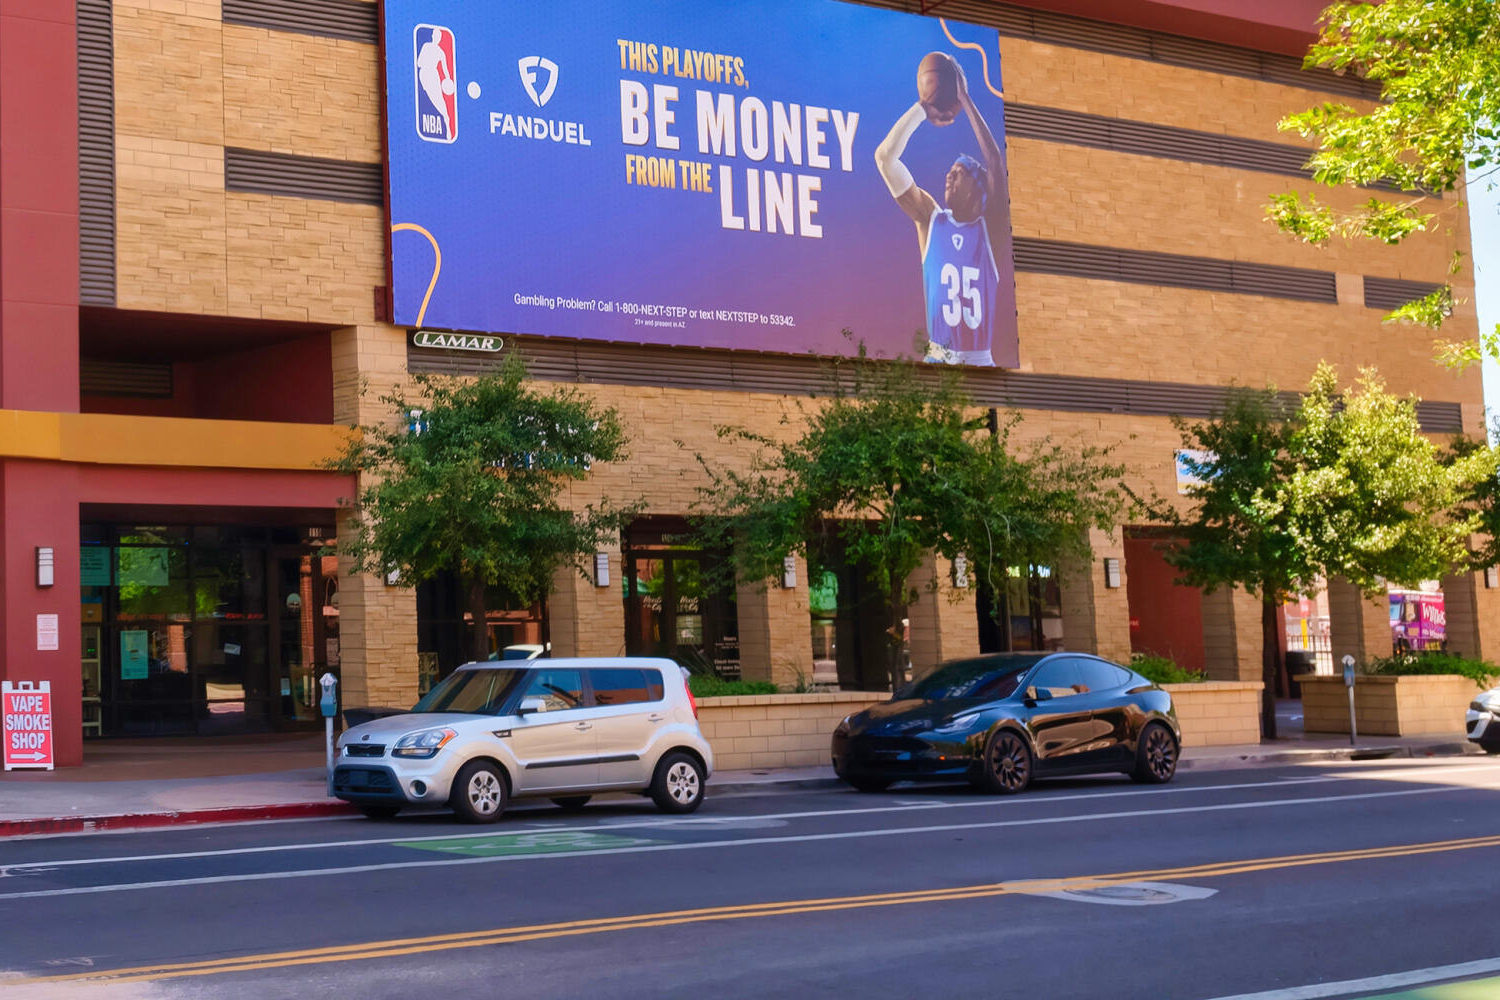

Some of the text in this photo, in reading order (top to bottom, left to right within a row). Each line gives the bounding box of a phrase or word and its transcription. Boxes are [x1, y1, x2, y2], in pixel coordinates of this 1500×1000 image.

[617, 38, 749, 89] THIS PLAYOFFS,
[422, 113, 443, 135] NBA
[489, 111, 592, 146] FANDUEL
[620, 79, 860, 172] BE MONEY
[625, 153, 713, 193] FROM THE
[719, 164, 823, 238] LINE
[514, 293, 796, 327] Gambling Problem? Call 1-800-NEXT-STEP or text NEXTSTEP to 53342.
[940, 262, 982, 330] 35
[421, 333, 495, 350] LAMAR
[11, 696, 44, 712] VAPE
[5, 714, 50, 731] SMOKE
[11, 733, 46, 749] SHOP
